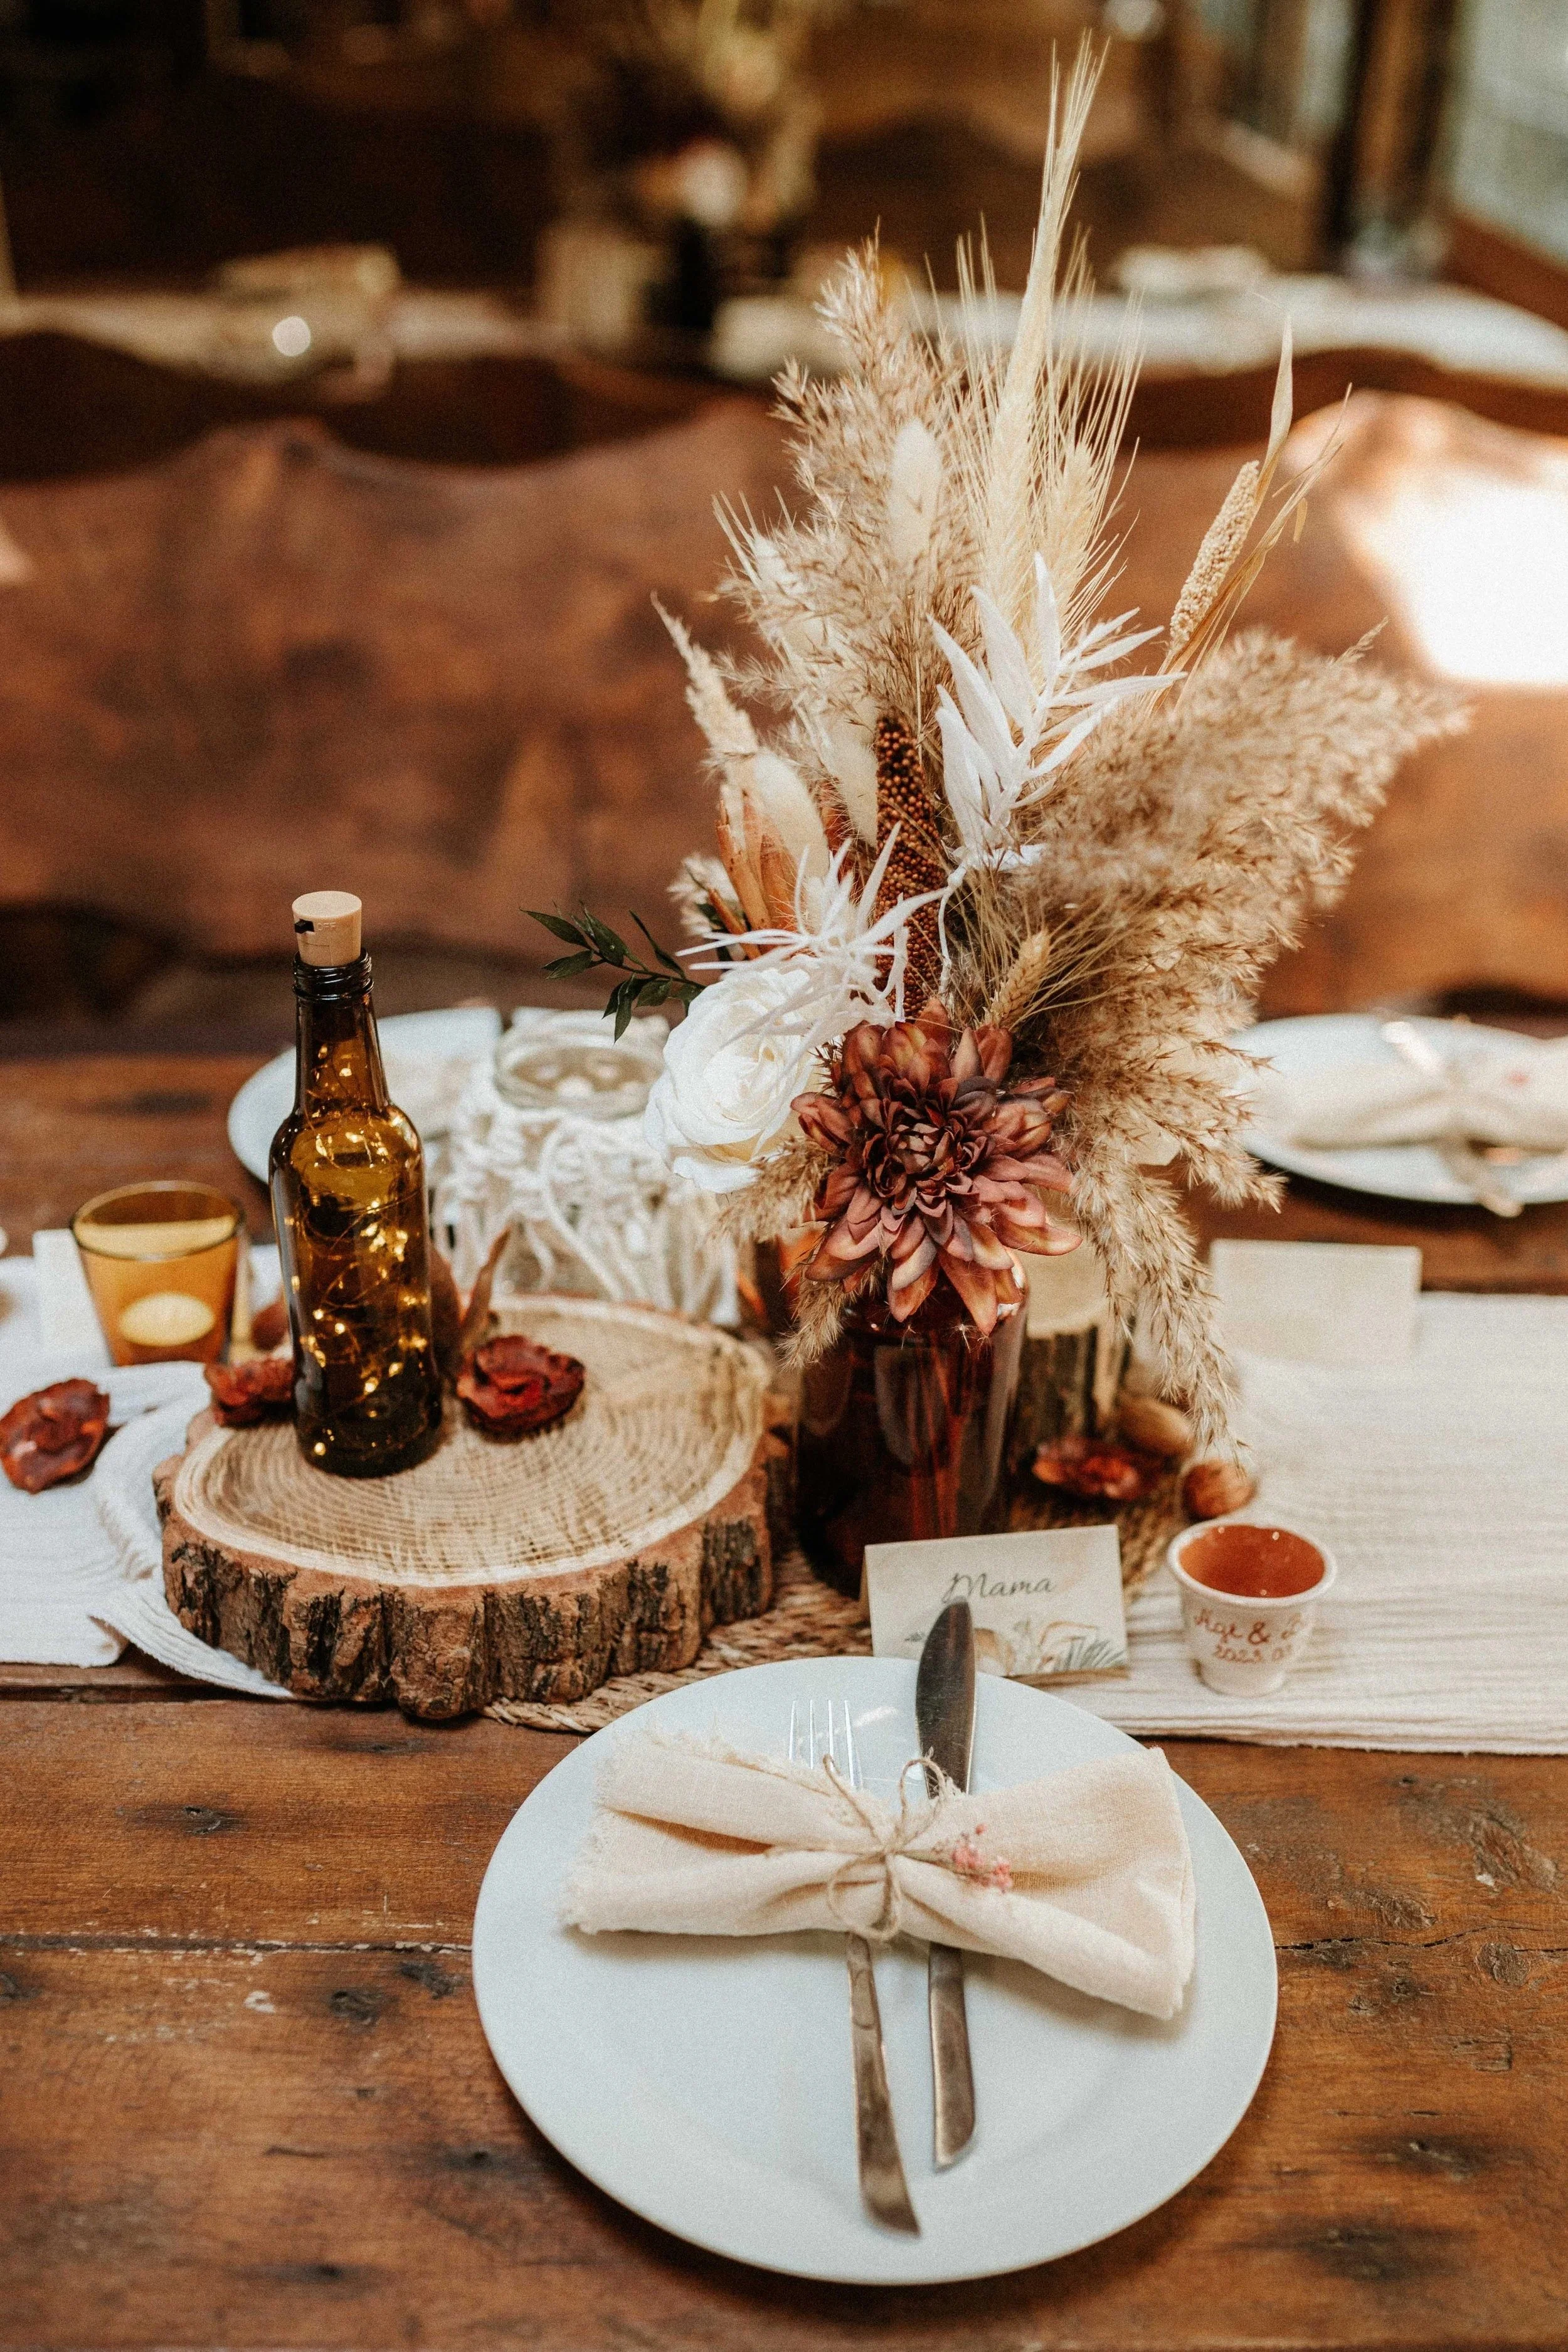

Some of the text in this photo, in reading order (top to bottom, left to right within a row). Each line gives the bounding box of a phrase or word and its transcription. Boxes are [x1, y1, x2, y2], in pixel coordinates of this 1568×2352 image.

[317, 921, 337, 931] OFF
[942, 1572, 1054, 1603] Mama
[1247, 1620, 1271, 1646] &
